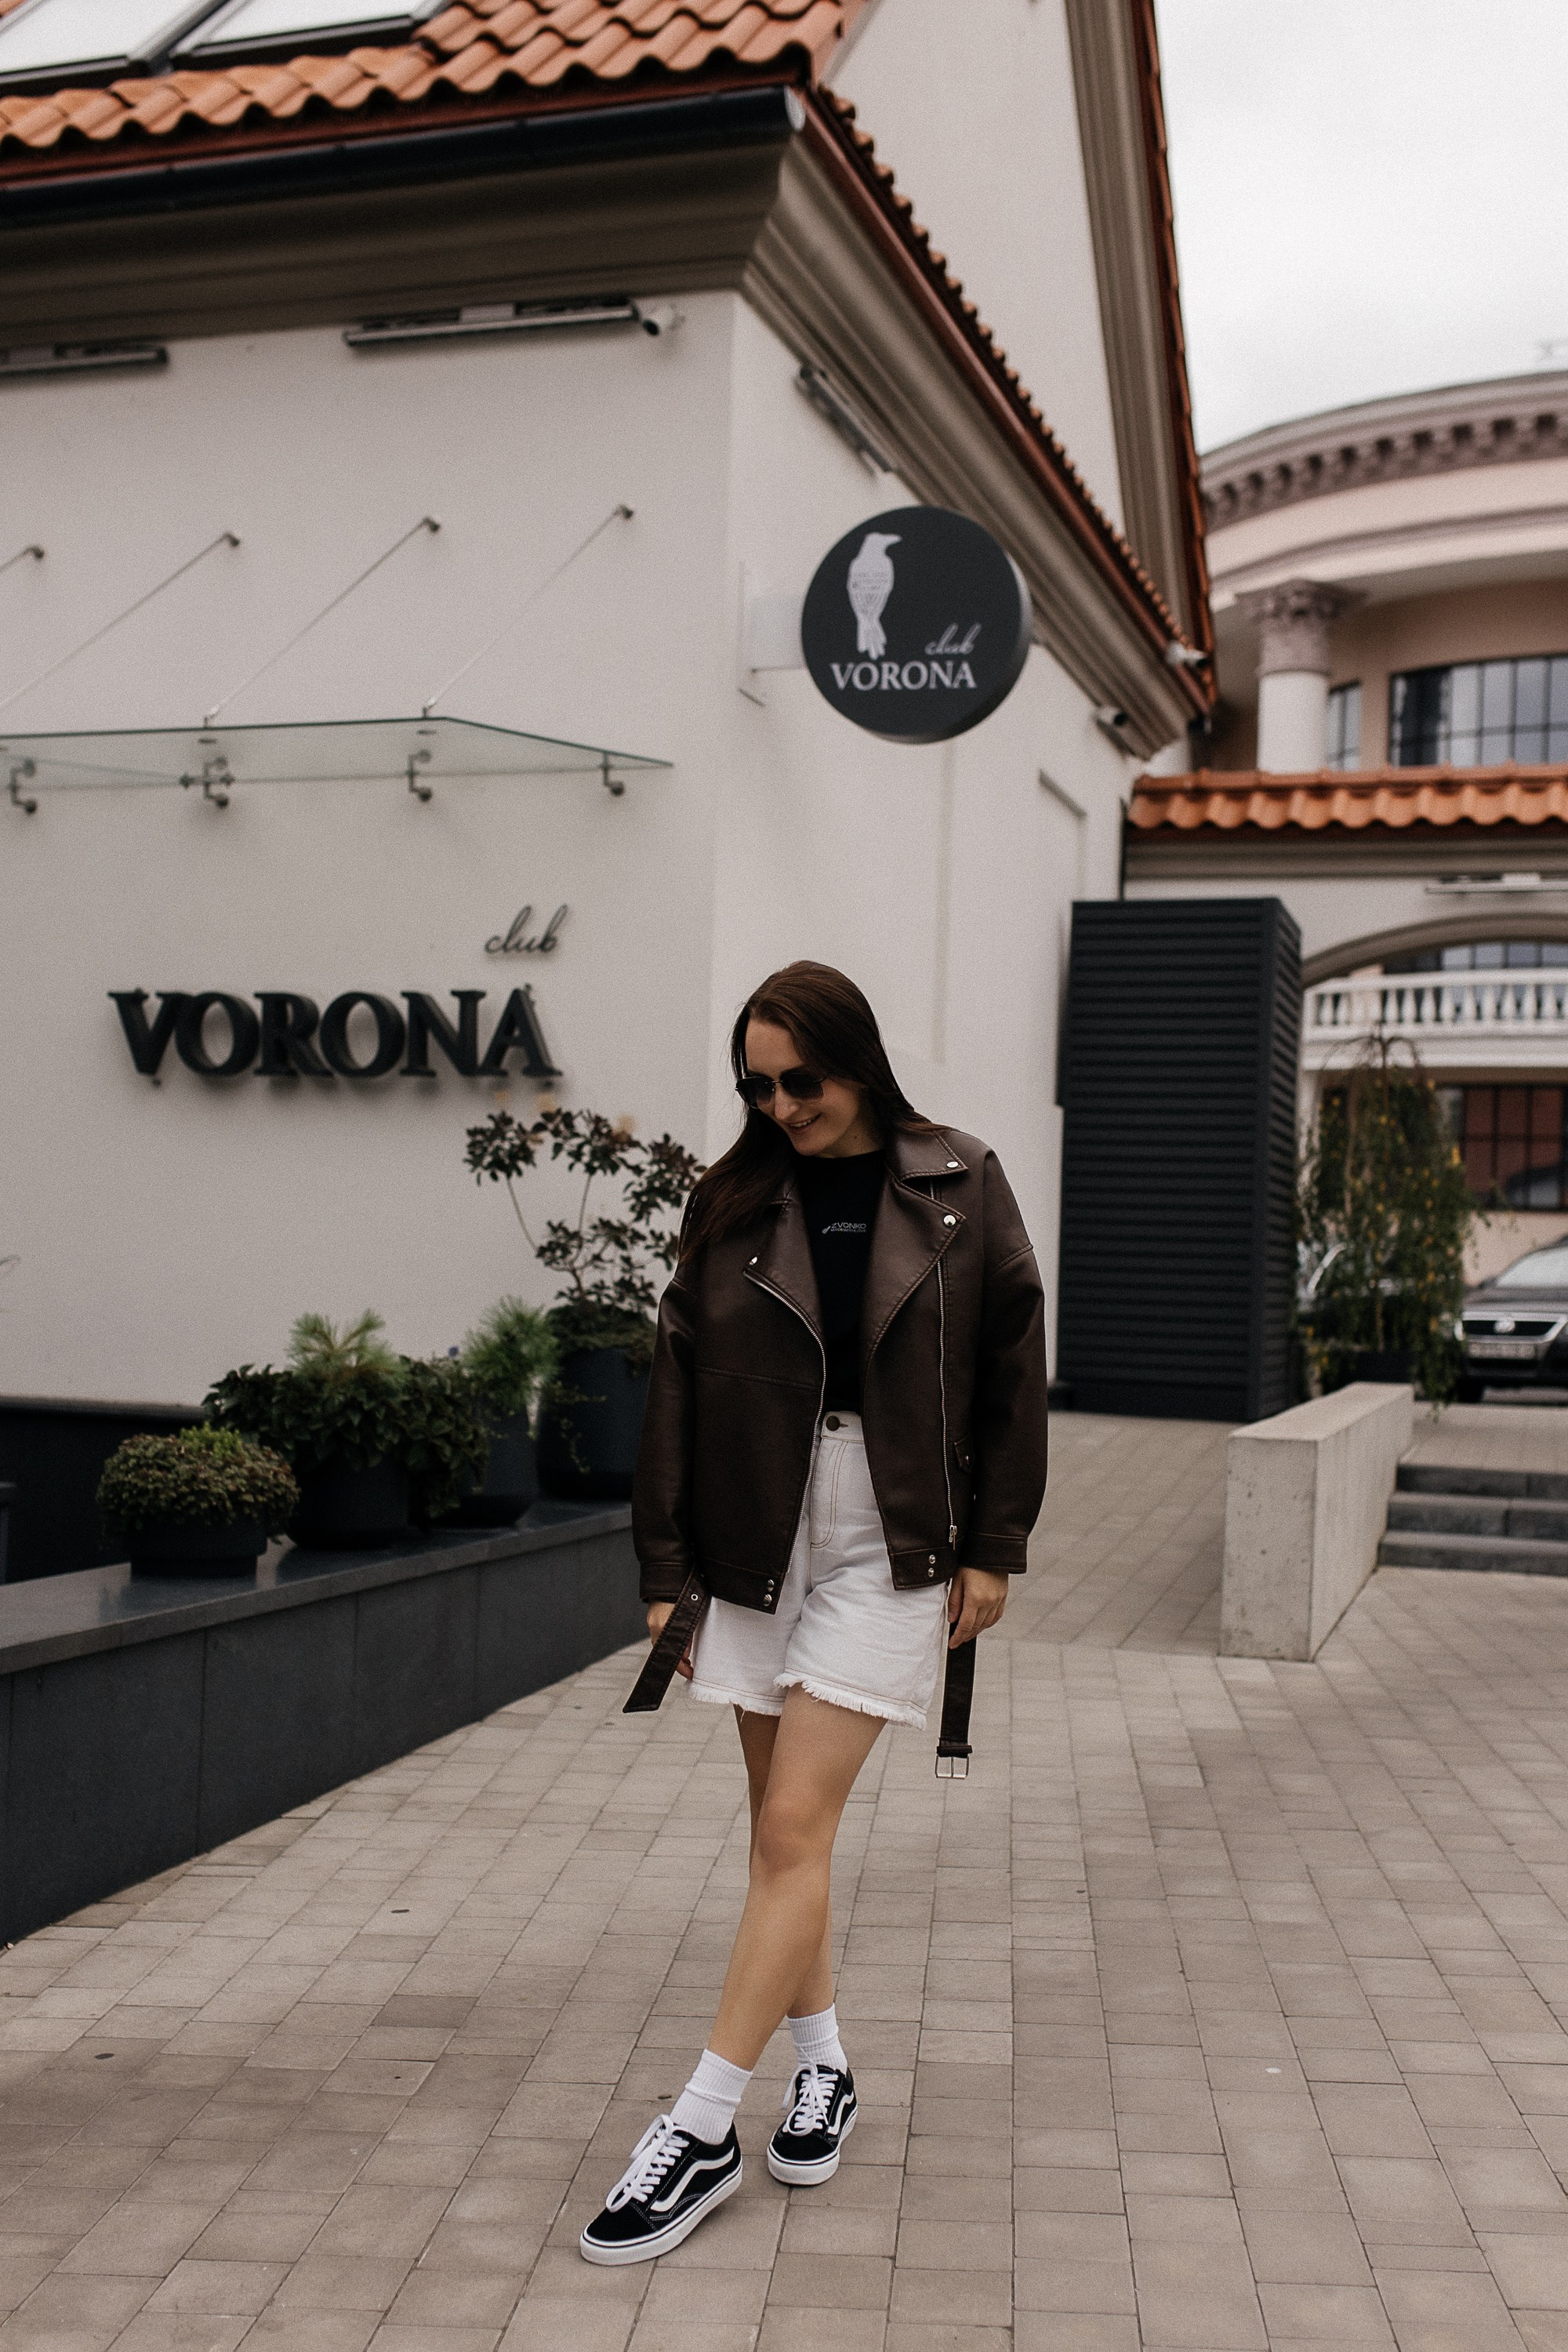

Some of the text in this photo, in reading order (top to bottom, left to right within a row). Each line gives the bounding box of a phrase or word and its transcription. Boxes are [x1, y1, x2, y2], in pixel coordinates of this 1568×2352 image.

[925, 622, 981, 655] club
[829, 661, 976, 691] VORONA
[484, 904, 569, 954] club
[107, 987, 564, 1079] VORONA
